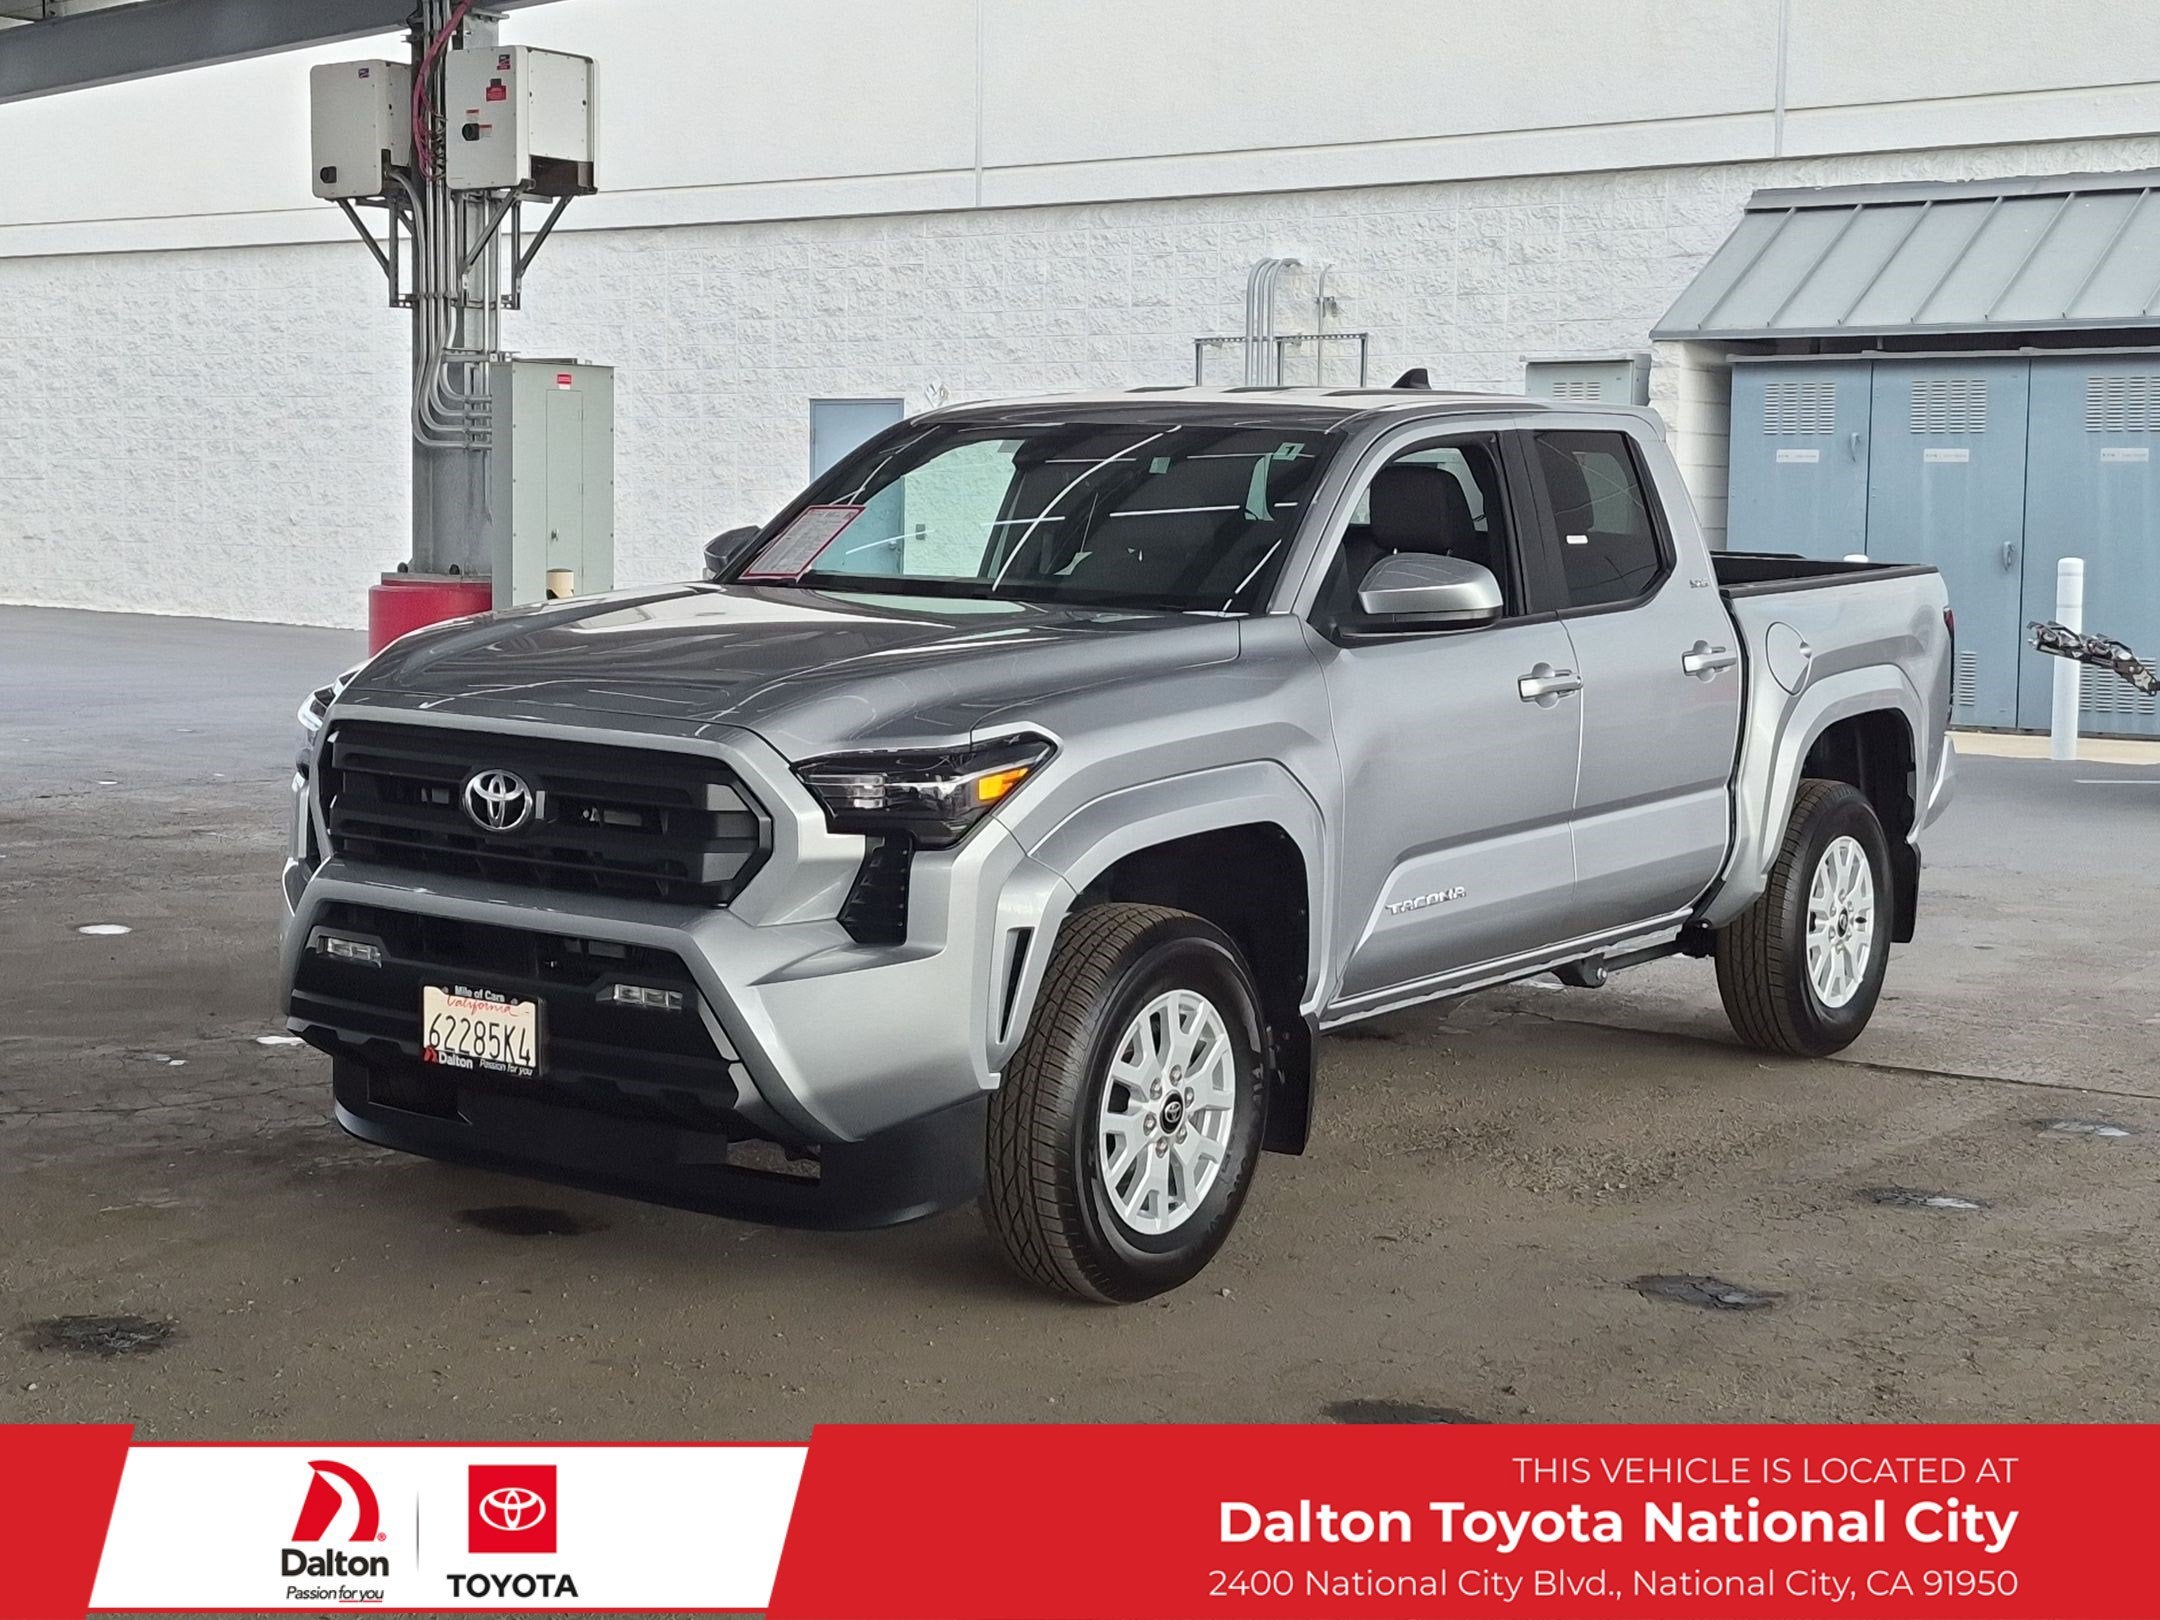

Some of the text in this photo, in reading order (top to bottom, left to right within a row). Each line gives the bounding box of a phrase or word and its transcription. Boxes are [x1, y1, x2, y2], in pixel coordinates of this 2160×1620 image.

[1386, 886, 1467, 915] TACOMA
[455, 985, 506, 1003] Mile of Cars
[429, 1013, 531, 1066] 62285K4
[438, 1051, 474, 1069] Dalton
[480, 1058, 533, 1076] Passion for you
